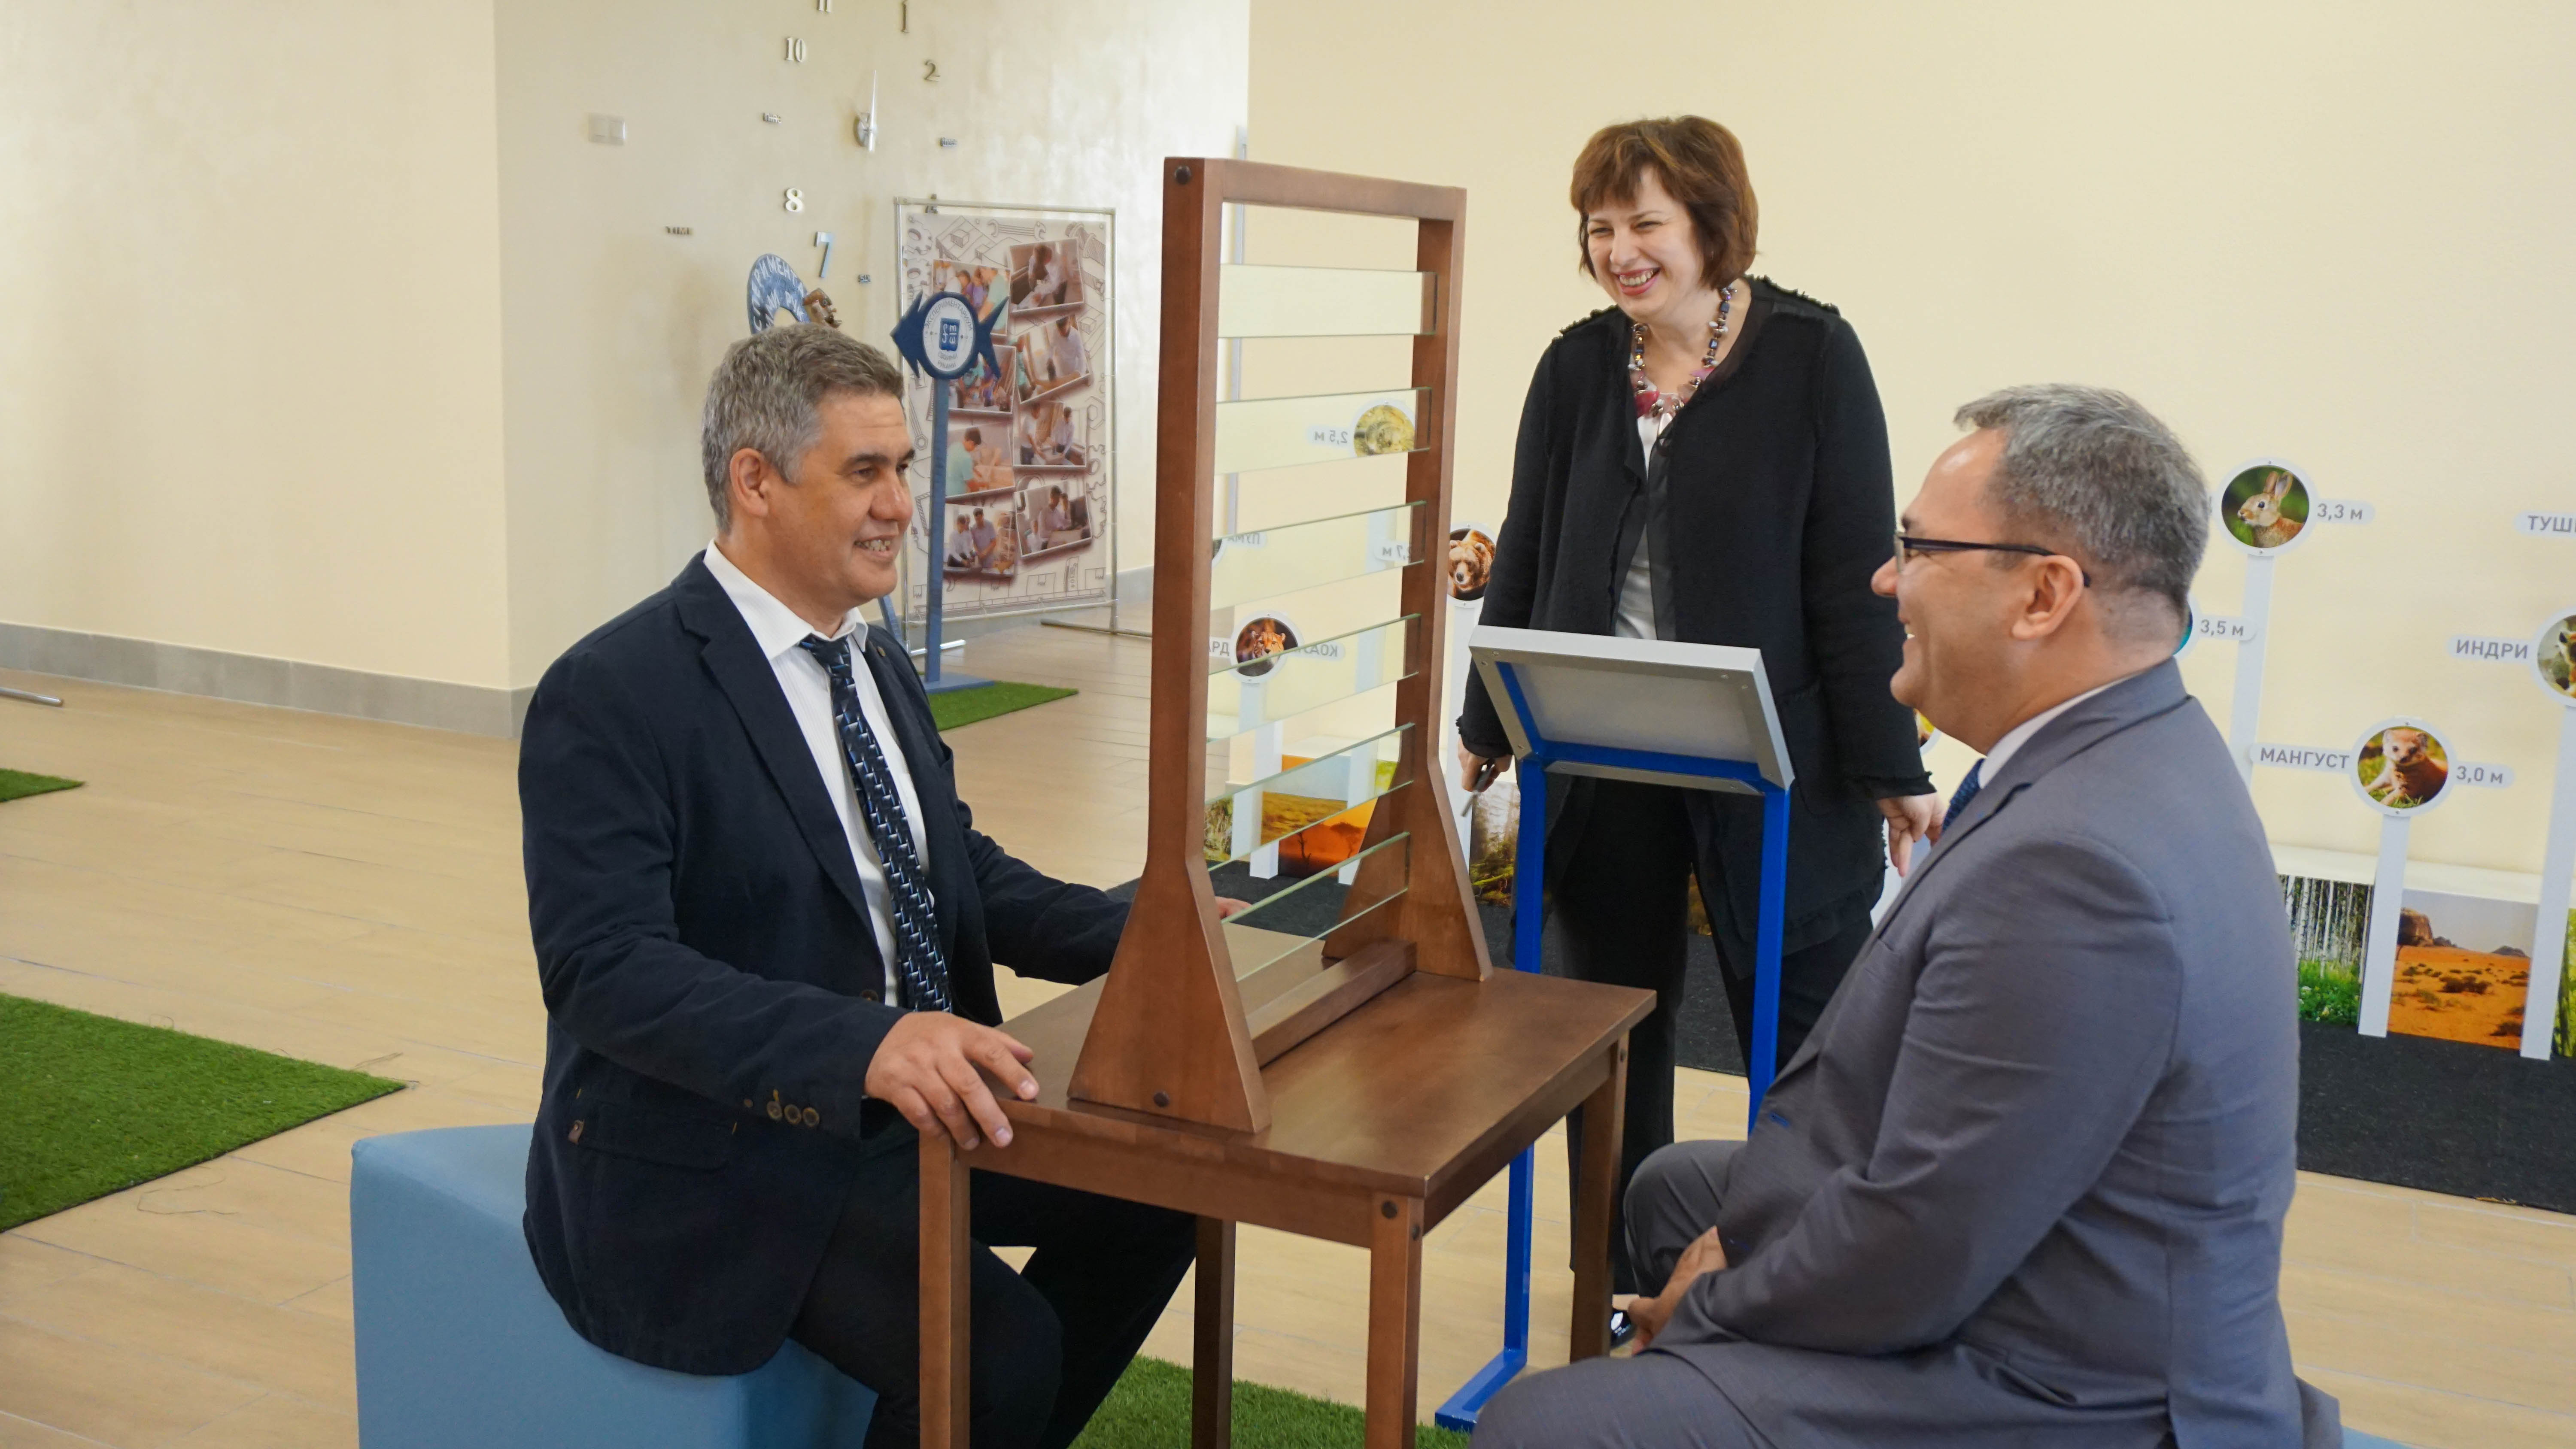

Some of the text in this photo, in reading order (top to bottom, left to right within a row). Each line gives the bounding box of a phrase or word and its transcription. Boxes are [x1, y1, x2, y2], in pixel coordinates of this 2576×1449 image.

[784, 37, 806, 62] 10
[924, 59, 941, 82] 2
[784, 188, 804, 212] 8
[814, 231, 834, 279] 7
[2317, 503, 2344, 521] 3,3
[2527, 515, 2576, 533] ТУШ
[2200, 619, 2226, 637] 3,5
[2456, 639, 2528, 660] ИНДРИ
[2260, 747, 2350, 769] МАНГУСТ
[2456, 766, 2485, 784] 3,0
